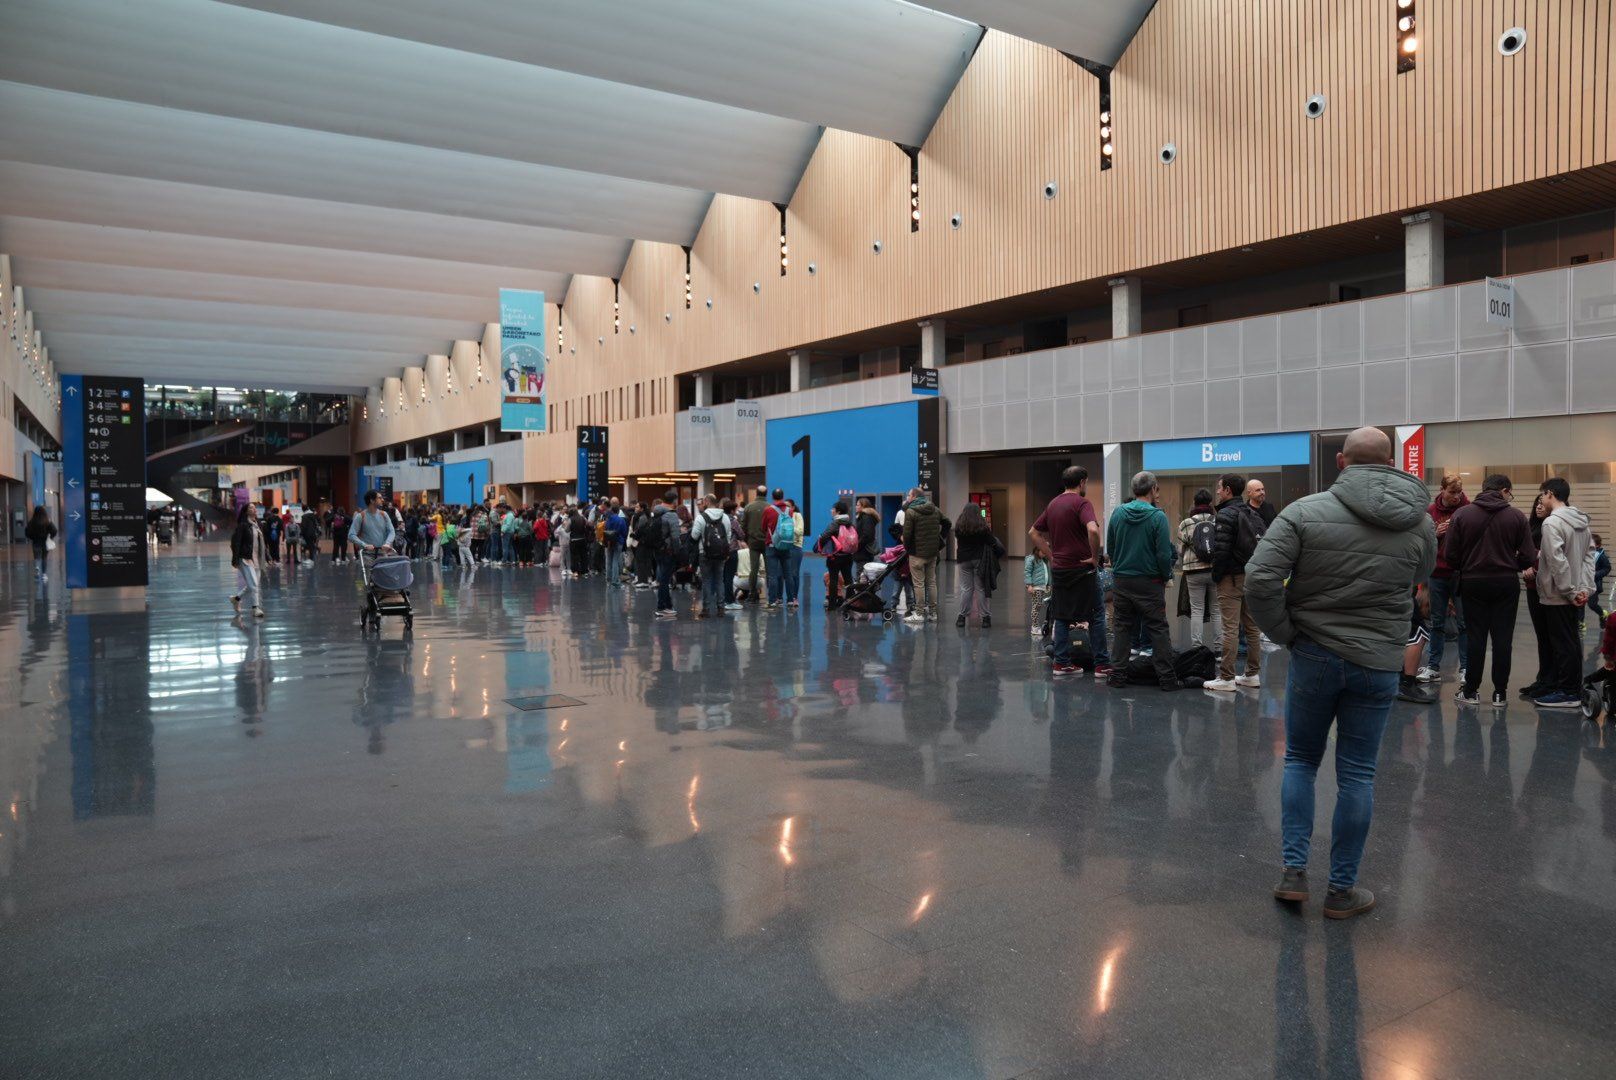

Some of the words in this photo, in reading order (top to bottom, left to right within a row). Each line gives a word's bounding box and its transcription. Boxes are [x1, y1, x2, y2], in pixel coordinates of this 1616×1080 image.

[1490, 299, 1511, 318] 01.01
[89, 388, 94, 398] 1
[96, 388, 103, 398] 2
[89, 401, 95, 410] 3
[96, 402, 104, 410] 4
[737, 409, 759, 417] 01.02
[89, 414, 95, 423] 5
[97, 414, 104, 423] 6
[691, 415, 711, 423] 01.03
[582, 430, 590, 443] 2
[600, 431, 606, 443] 1
[42, 451, 56, 460] WC
[1215, 450, 1242, 462] travel
[791, 434, 811, 536] 1
[101, 502, 109, 511] 4
